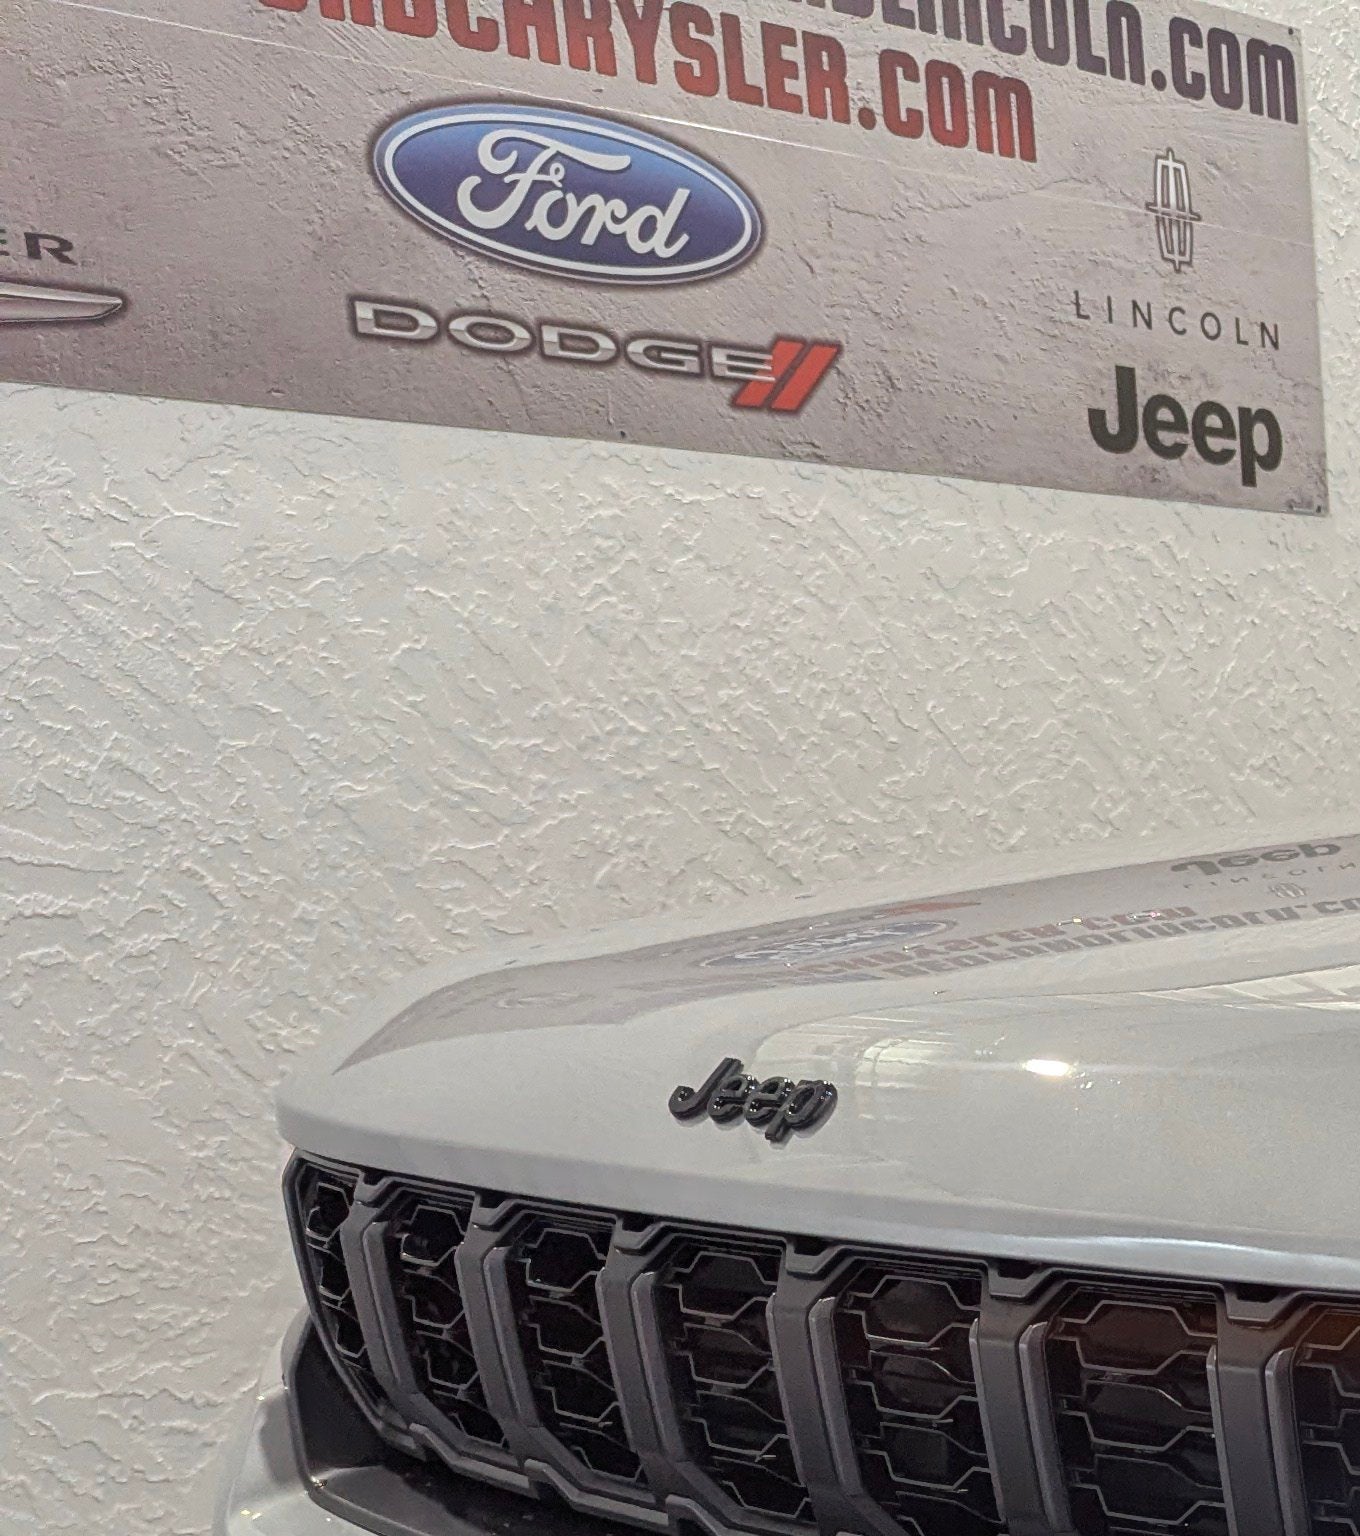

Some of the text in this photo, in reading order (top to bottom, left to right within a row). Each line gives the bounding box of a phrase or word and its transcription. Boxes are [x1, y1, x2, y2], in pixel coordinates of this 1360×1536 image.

[456, 129, 690, 259] Ford
[352, 299, 776, 382] DODGE
[1073, 290, 1281, 351] LINCOLN
[1088, 365, 1283, 487] Jeep
[668, 1056, 838, 1144] Jeep
